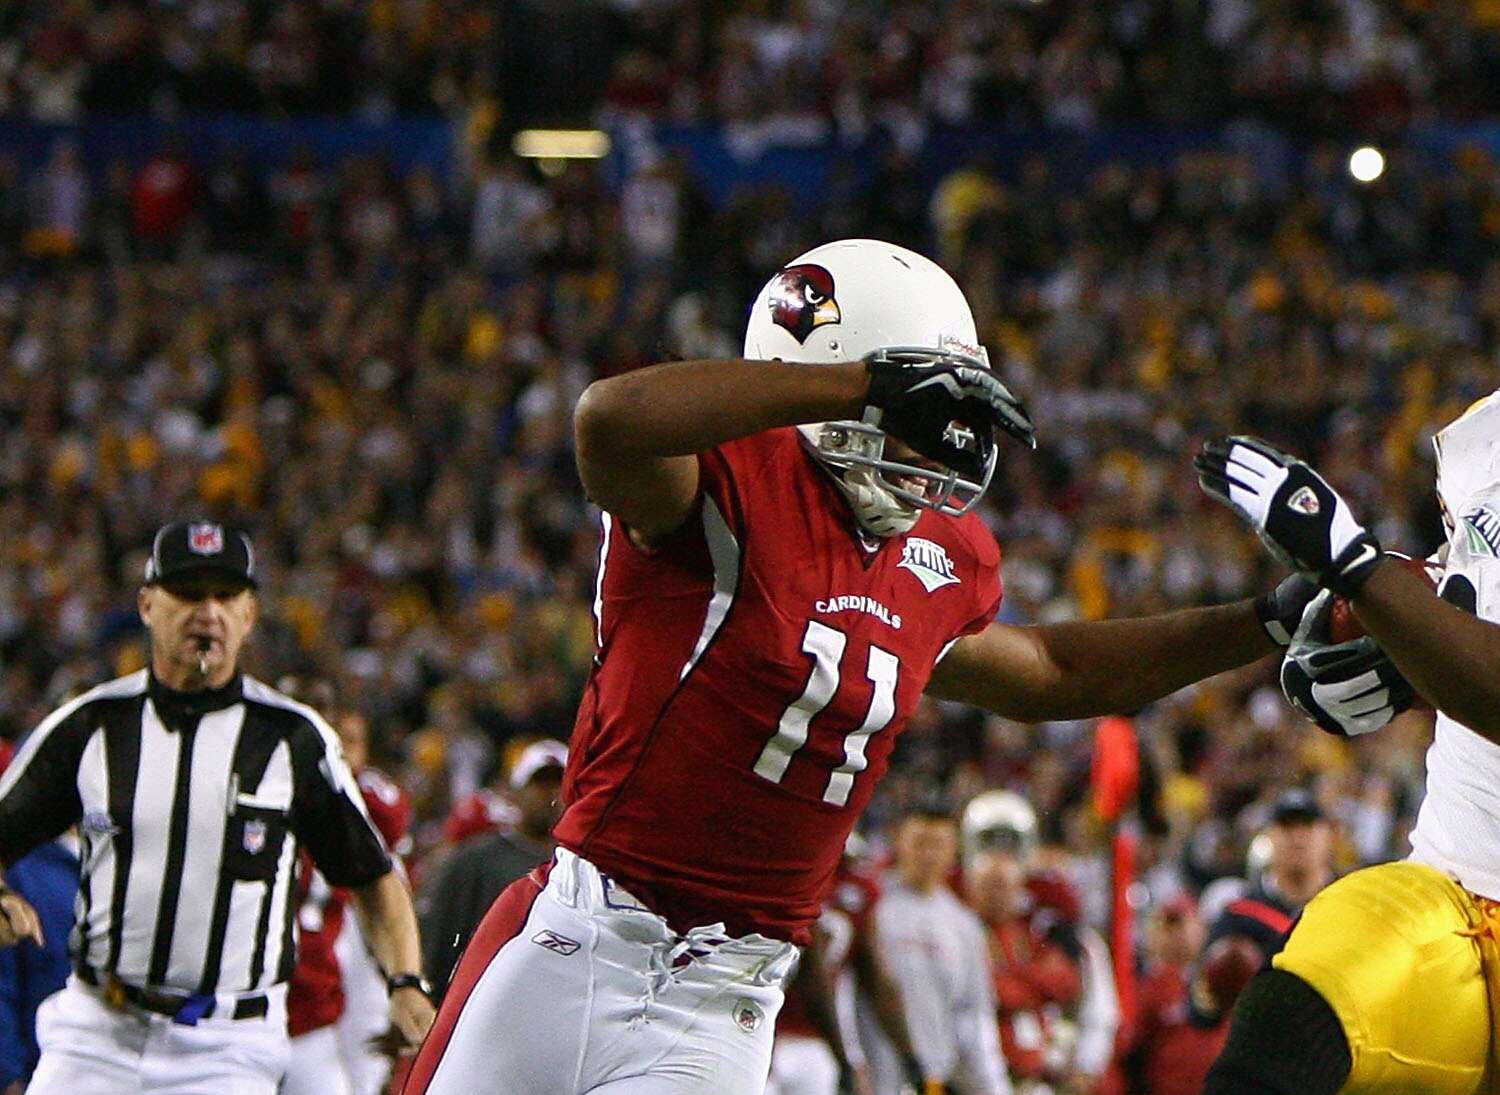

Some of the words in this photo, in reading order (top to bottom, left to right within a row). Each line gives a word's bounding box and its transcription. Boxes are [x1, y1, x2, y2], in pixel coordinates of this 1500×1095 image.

[905, 545, 951, 580] XLIII
[815, 595, 901, 629] CARDINALS
[753, 620, 899, 807] 11
